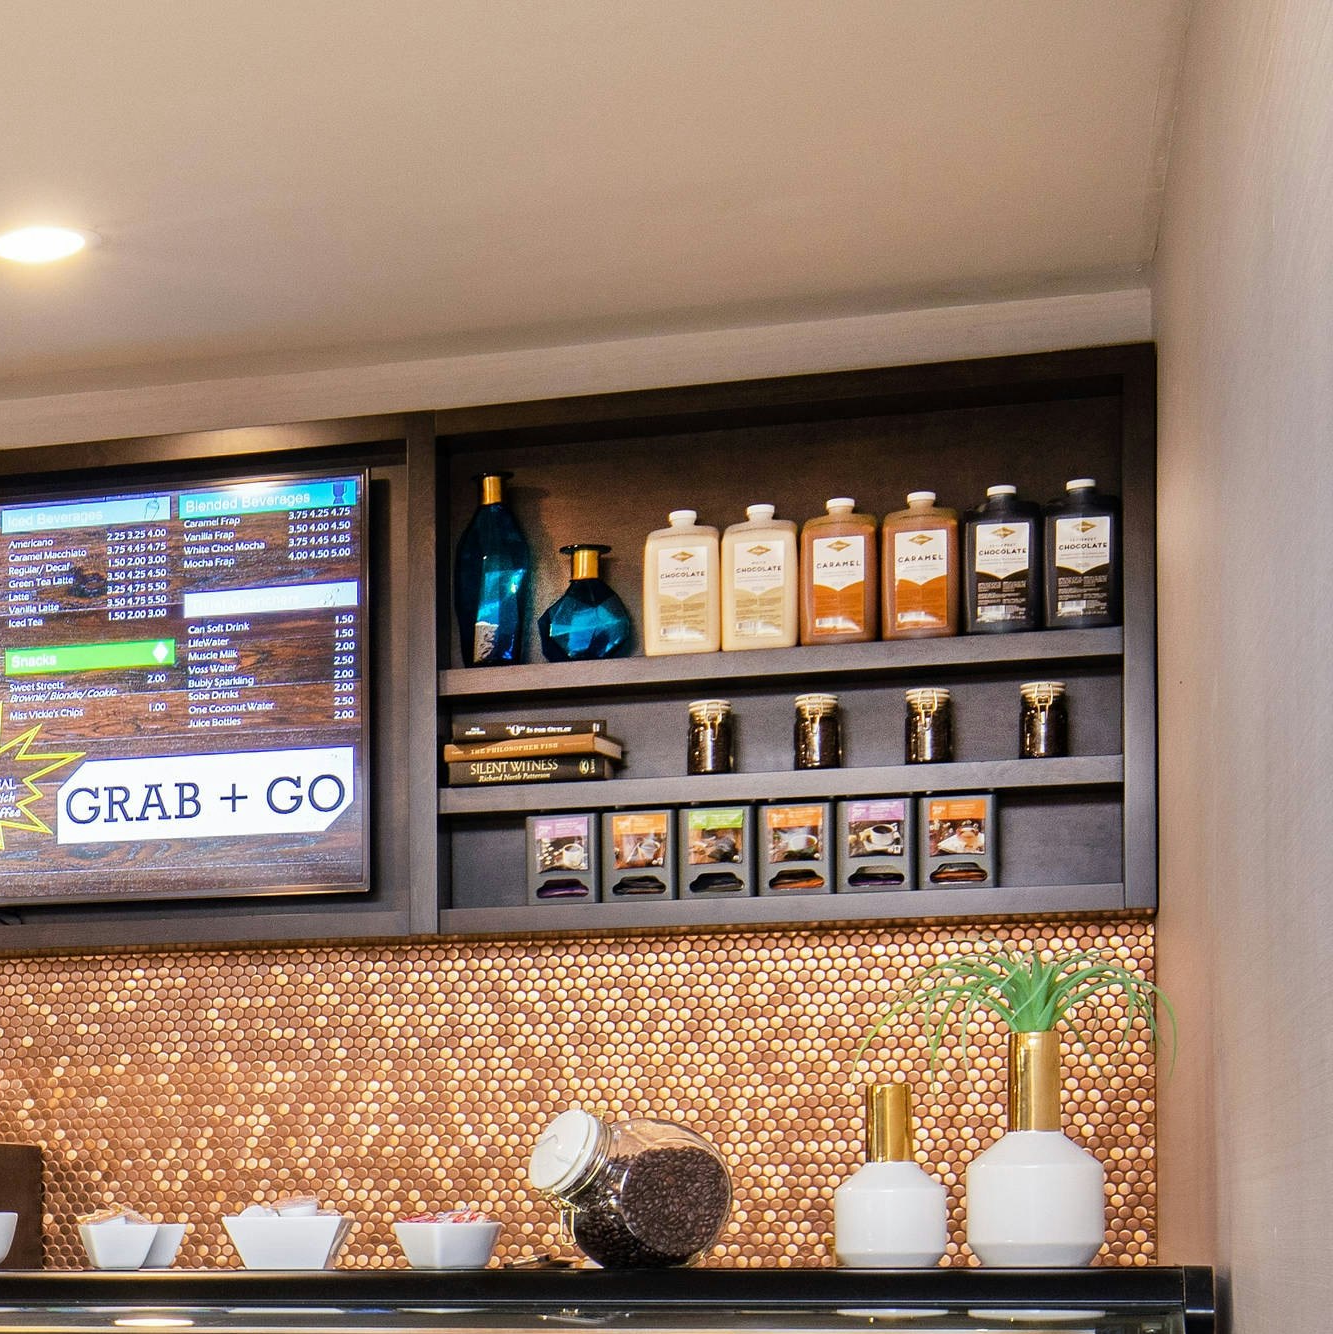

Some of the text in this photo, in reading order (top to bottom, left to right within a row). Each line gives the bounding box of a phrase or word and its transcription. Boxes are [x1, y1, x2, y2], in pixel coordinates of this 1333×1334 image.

[186, 493, 310, 512] Blended Beverages
[8, 510, 103, 527] Iced Beverages
[184, 508, 350, 528] Caramel Frap 3.75 4.25 4.75
[9, 529, 166, 549] Americano 2.25 3.25 4.00
[184, 546, 209, 555] White
[211, 544, 233, 553] Choc
[235, 542, 265, 550] Mocha
[288, 538, 307, 547] 3.75
[310, 536, 329, 545] 4.45
[1058, 542, 1107, 551] CHOCOLATE
[9, 549, 87, 562] Caramel Macchiato
[184, 548, 350, 568] Mocha Frap 4.00 4.50 5.00
[897, 554, 944, 564] CARAMEL
[979, 547, 1027, 556] CHOCOLATE
[736, 565, 782, 574] CHOCOLATE
[816, 560, 861, 569] CARAMEL
[660, 570, 705, 580] CHOCOLATE
[9, 609, 166, 628] Iced Tea 1.50 2.00 3.00
[188, 615, 353, 634] Can Soft Drink 1.50
[188, 638, 229, 648] LifeWater
[188, 642, 355, 661] Muscle Milk 2.00
[11, 655, 56, 667] Snacks
[188, 656, 353, 675] Voss Water 2.50
[487, 744, 539, 753] PHILOSOPHER
[471, 759, 558, 775] SILENT WITNESS
[479, 774, 502, 782] Richard
[504, 773, 521, 781] North
[66, 774, 345, 824] GRAB + GO
